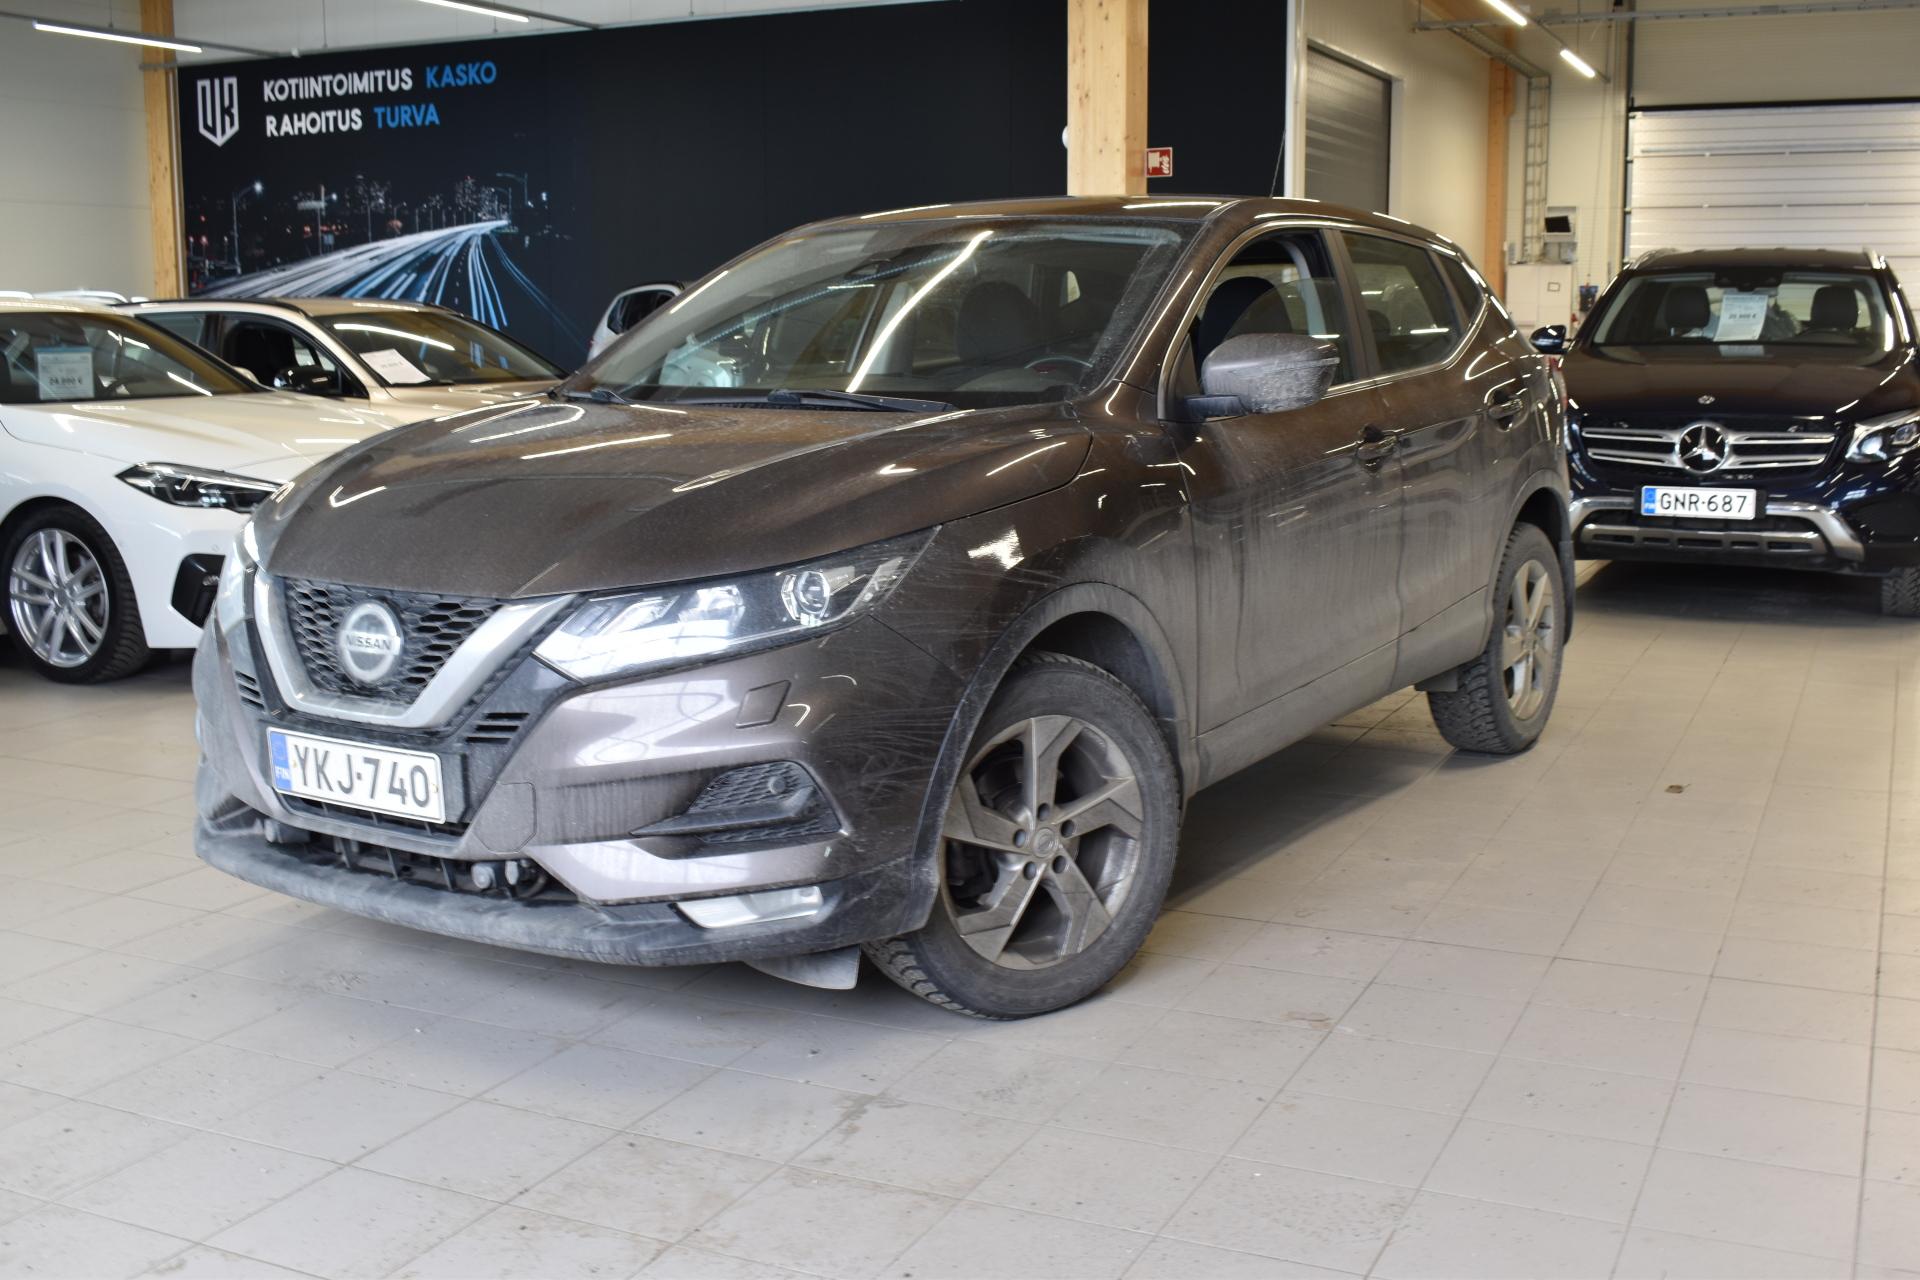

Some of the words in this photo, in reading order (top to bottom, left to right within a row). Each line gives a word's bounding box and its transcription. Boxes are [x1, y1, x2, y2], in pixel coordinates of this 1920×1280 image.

[264, 68, 413, 102] KOTIINTOIMITUS
[426, 61, 497, 89] KASKO
[266, 108, 363, 137] RAHOITUS
[374, 103, 440, 129] TURVA
[1660, 492, 1747, 513] GNR-687
[346, 634, 391, 650] NISSAN
[294, 744, 431, 808] YKJ-740
